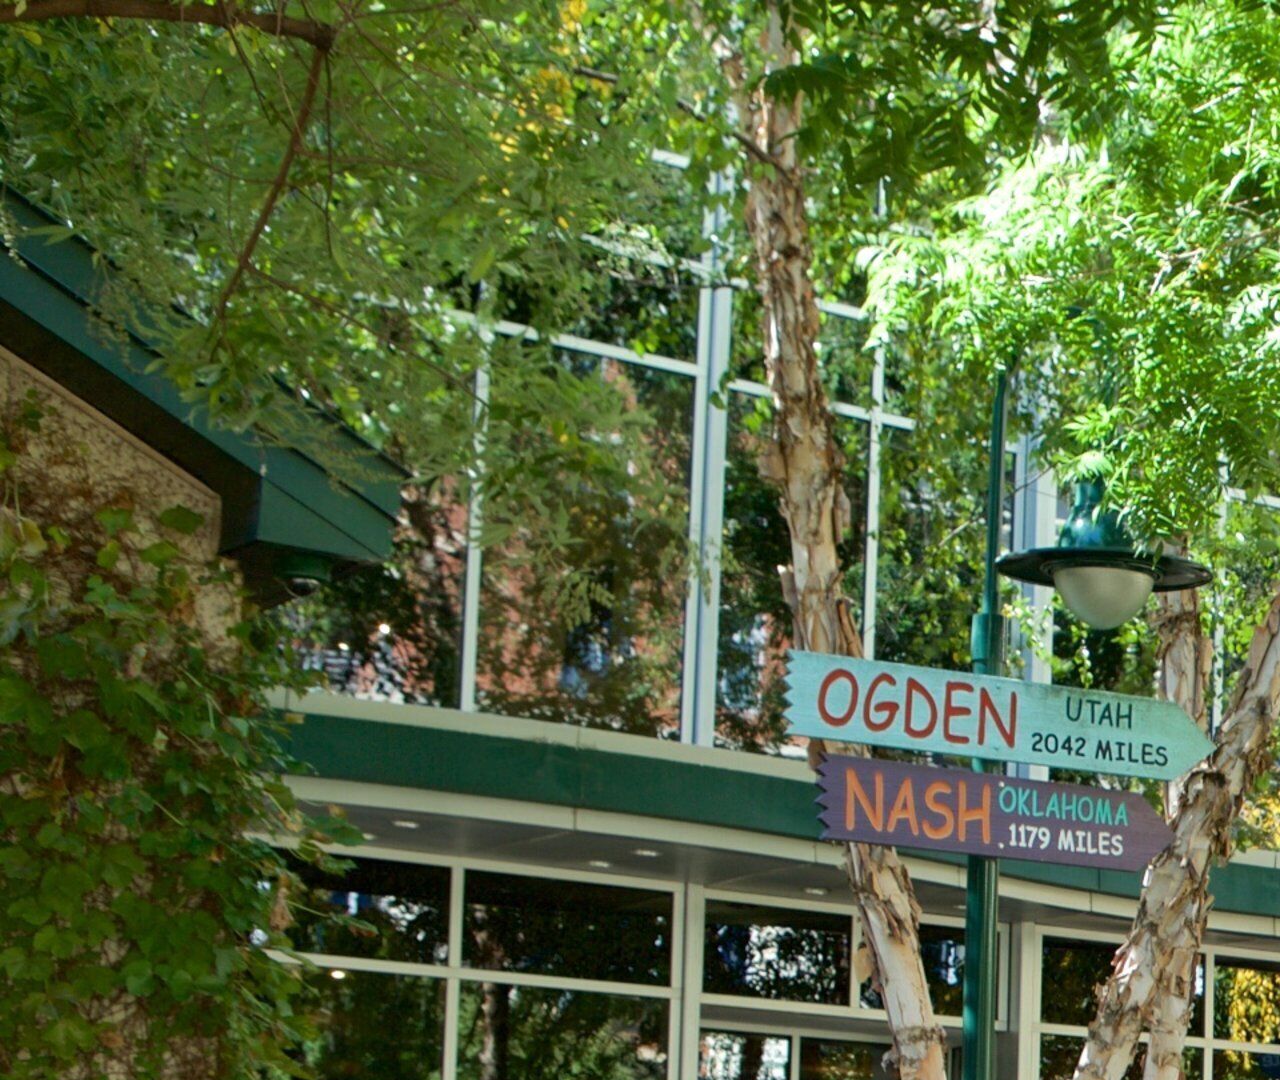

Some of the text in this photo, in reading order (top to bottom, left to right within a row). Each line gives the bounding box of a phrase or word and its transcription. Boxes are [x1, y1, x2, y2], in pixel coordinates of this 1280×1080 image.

[818, 668, 1018, 748] OGDEN
[1066, 696, 1134, 729] UTAH
[1031, 732, 1169, 767] 2042 MILES
[845, 768, 992, 844] NASH
[998, 785, 1129, 827] OKLAHOMA
[1009, 824, 1124, 857] 1179 MILES
